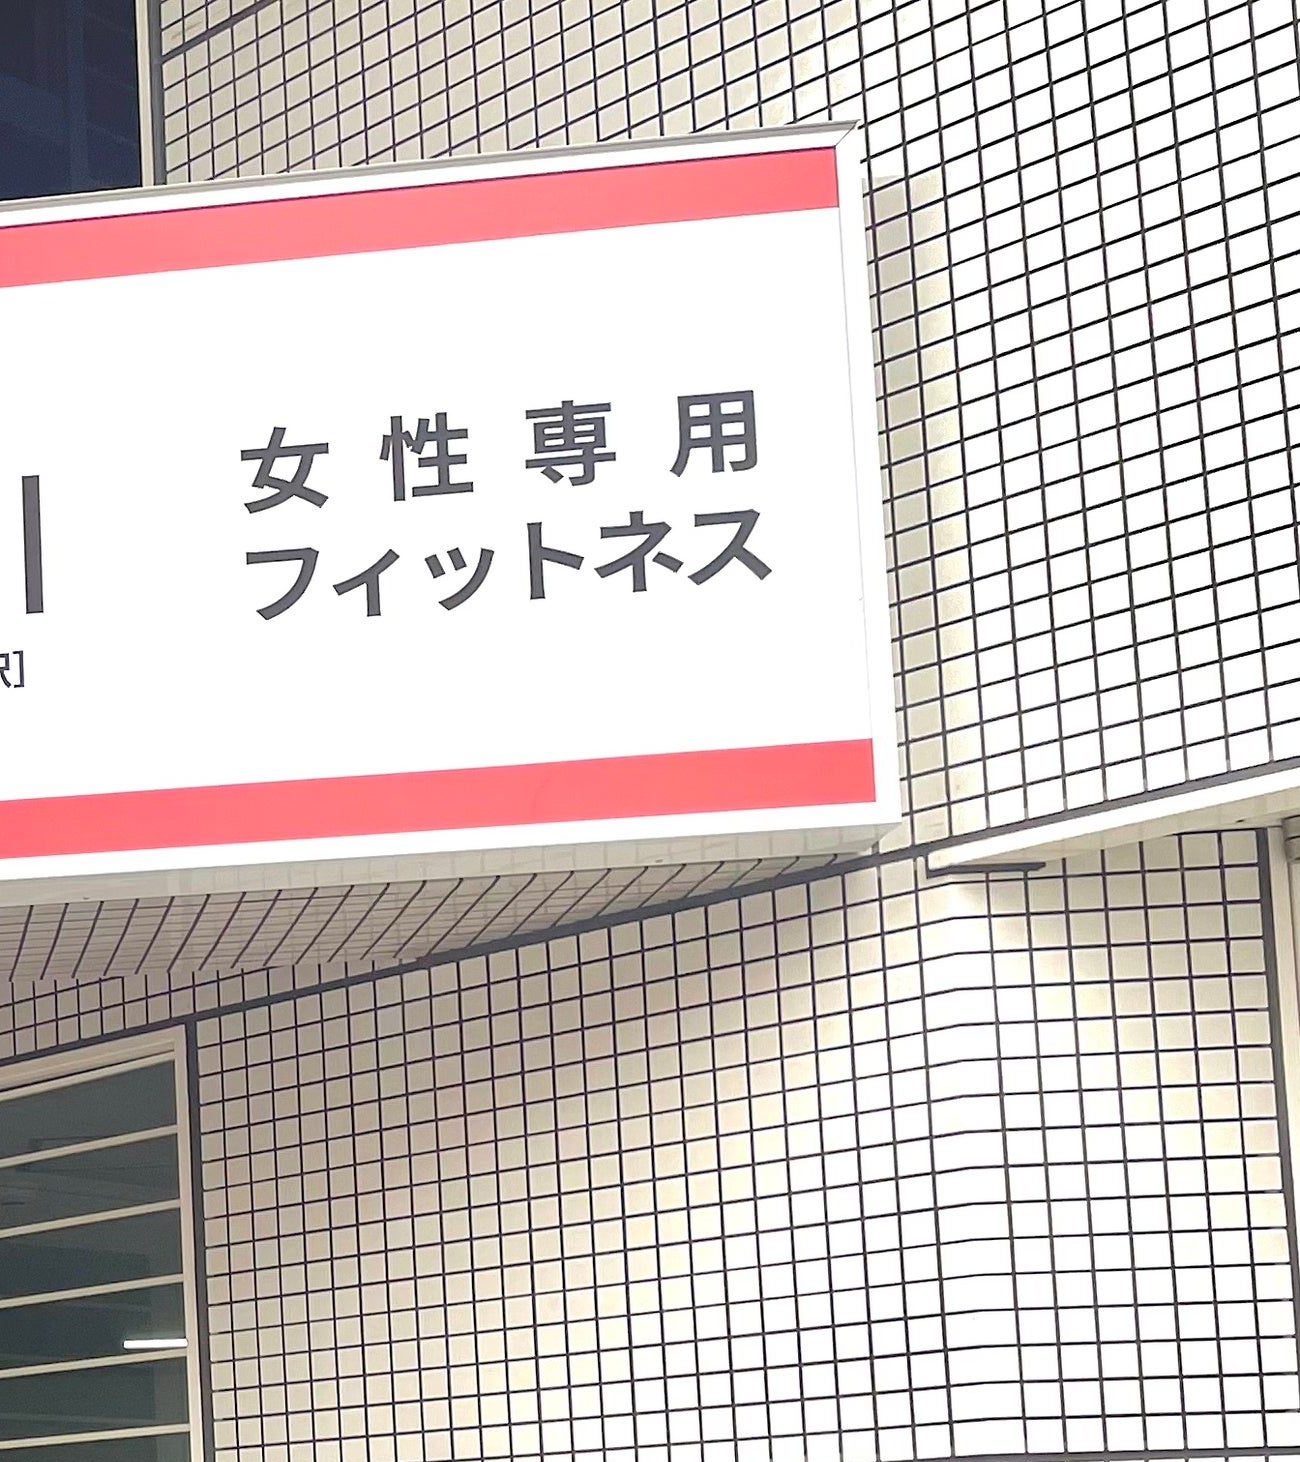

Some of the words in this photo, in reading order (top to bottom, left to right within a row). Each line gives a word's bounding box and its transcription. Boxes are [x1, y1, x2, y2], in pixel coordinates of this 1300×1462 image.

[240, 390, 759, 513] 女性専用
[244, 507, 773, 622] フィットネス
